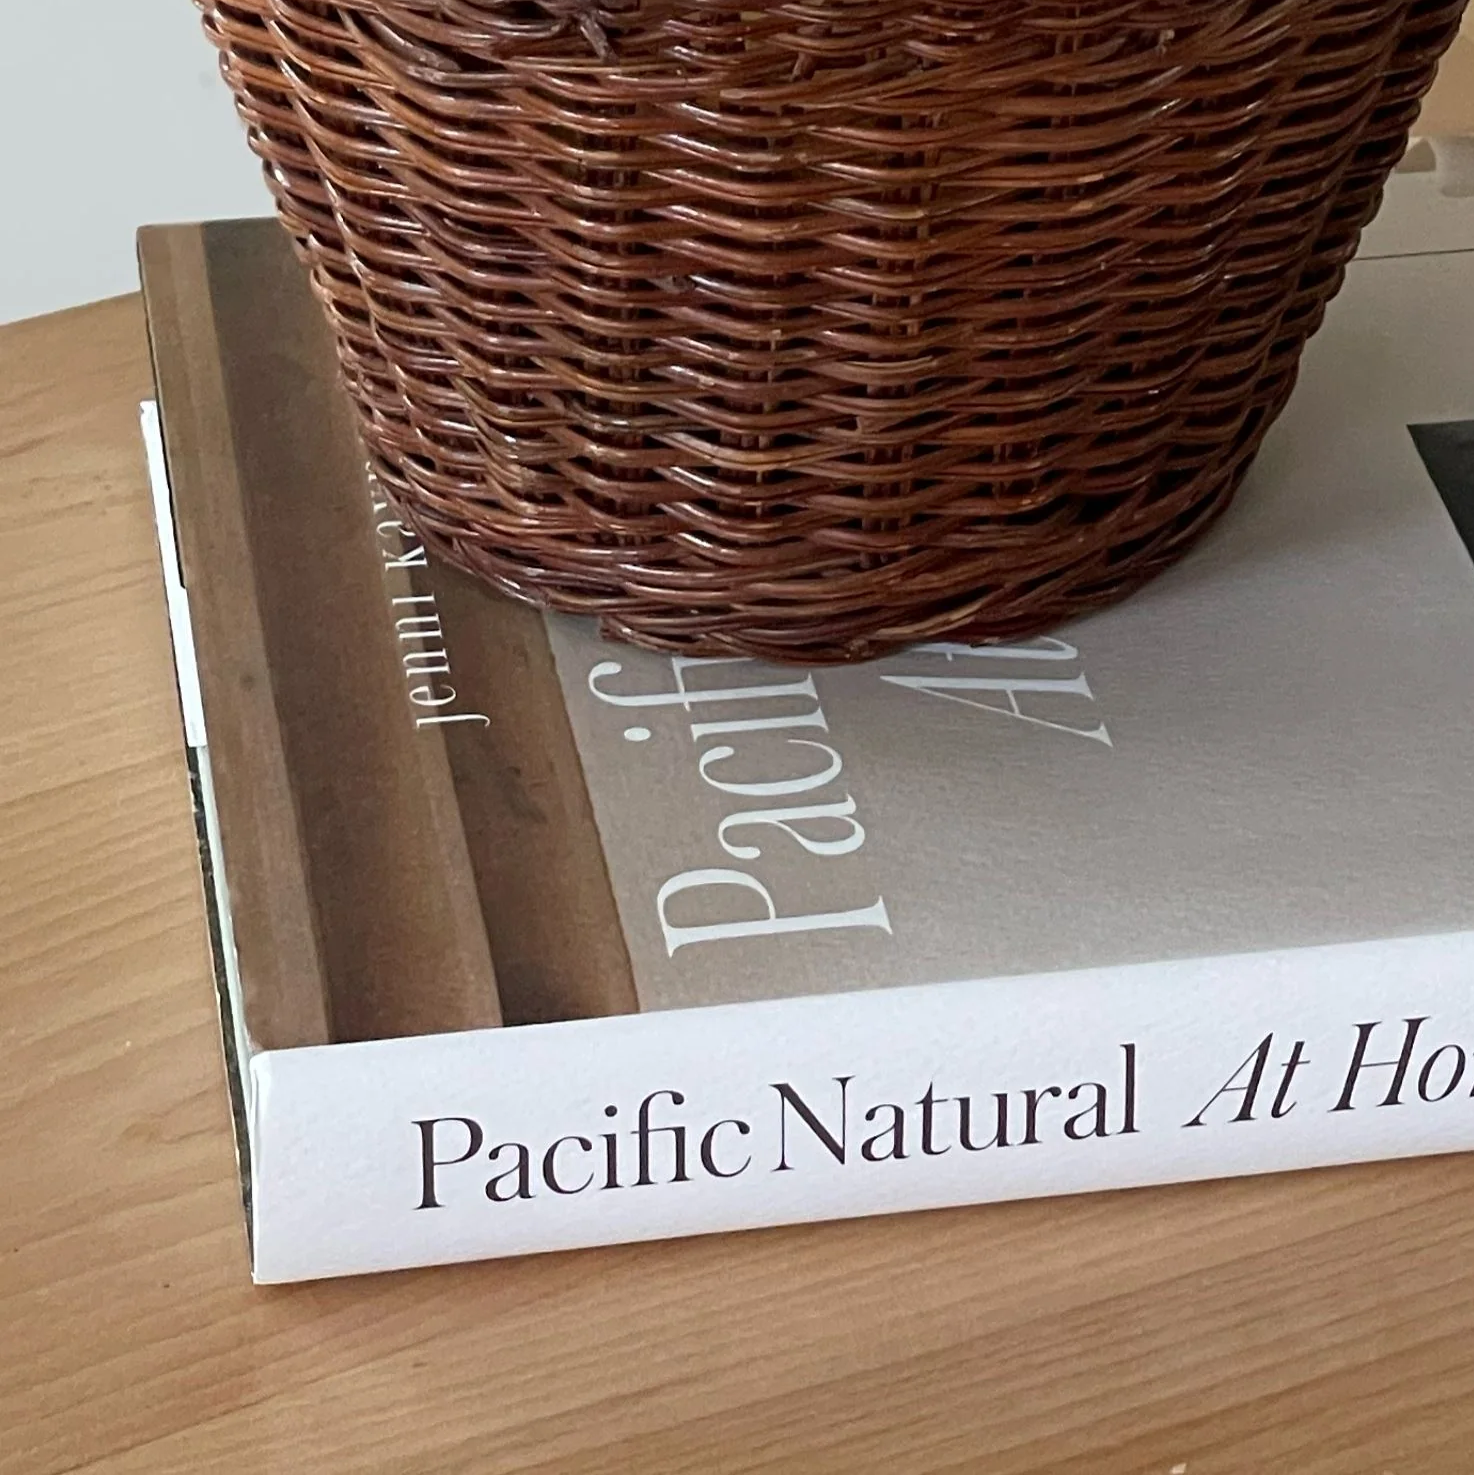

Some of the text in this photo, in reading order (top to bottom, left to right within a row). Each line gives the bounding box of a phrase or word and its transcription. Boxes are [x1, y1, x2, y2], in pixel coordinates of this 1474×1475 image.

[411, 1089, 752, 1210] Pacific
[769, 1042, 1141, 1172] Natural
[1181, 1032, 1311, 1128] At
